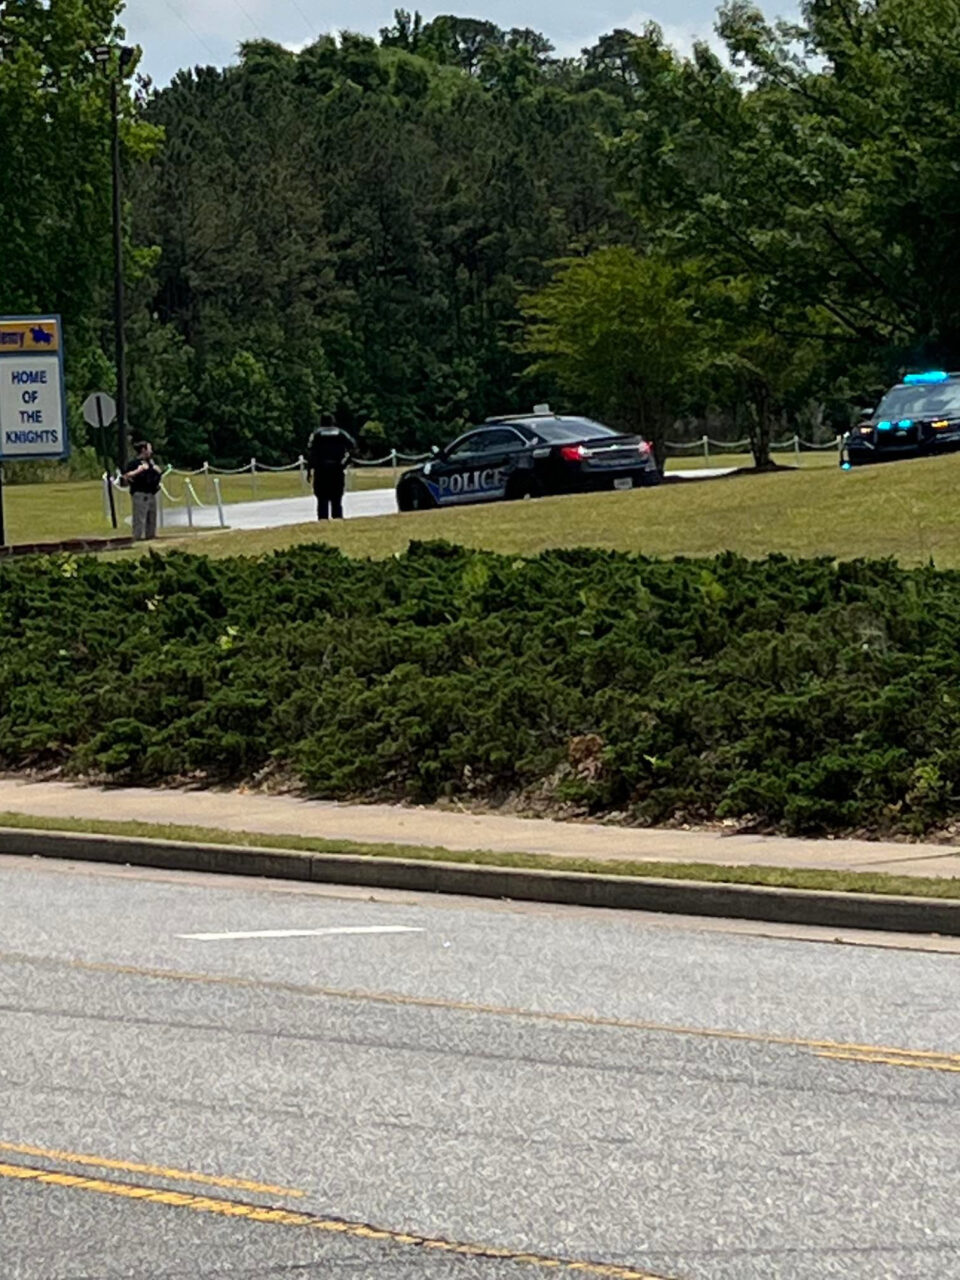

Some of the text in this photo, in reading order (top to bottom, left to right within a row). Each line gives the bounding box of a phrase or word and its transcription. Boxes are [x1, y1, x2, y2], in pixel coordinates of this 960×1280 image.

[11, 370, 47, 384] HOME
[21, 390, 39, 404] OF
[19, 410, 43, 423] THE
[5, 429, 58, 444] KNIGHTS
[439, 468, 506, 494] POLICE
